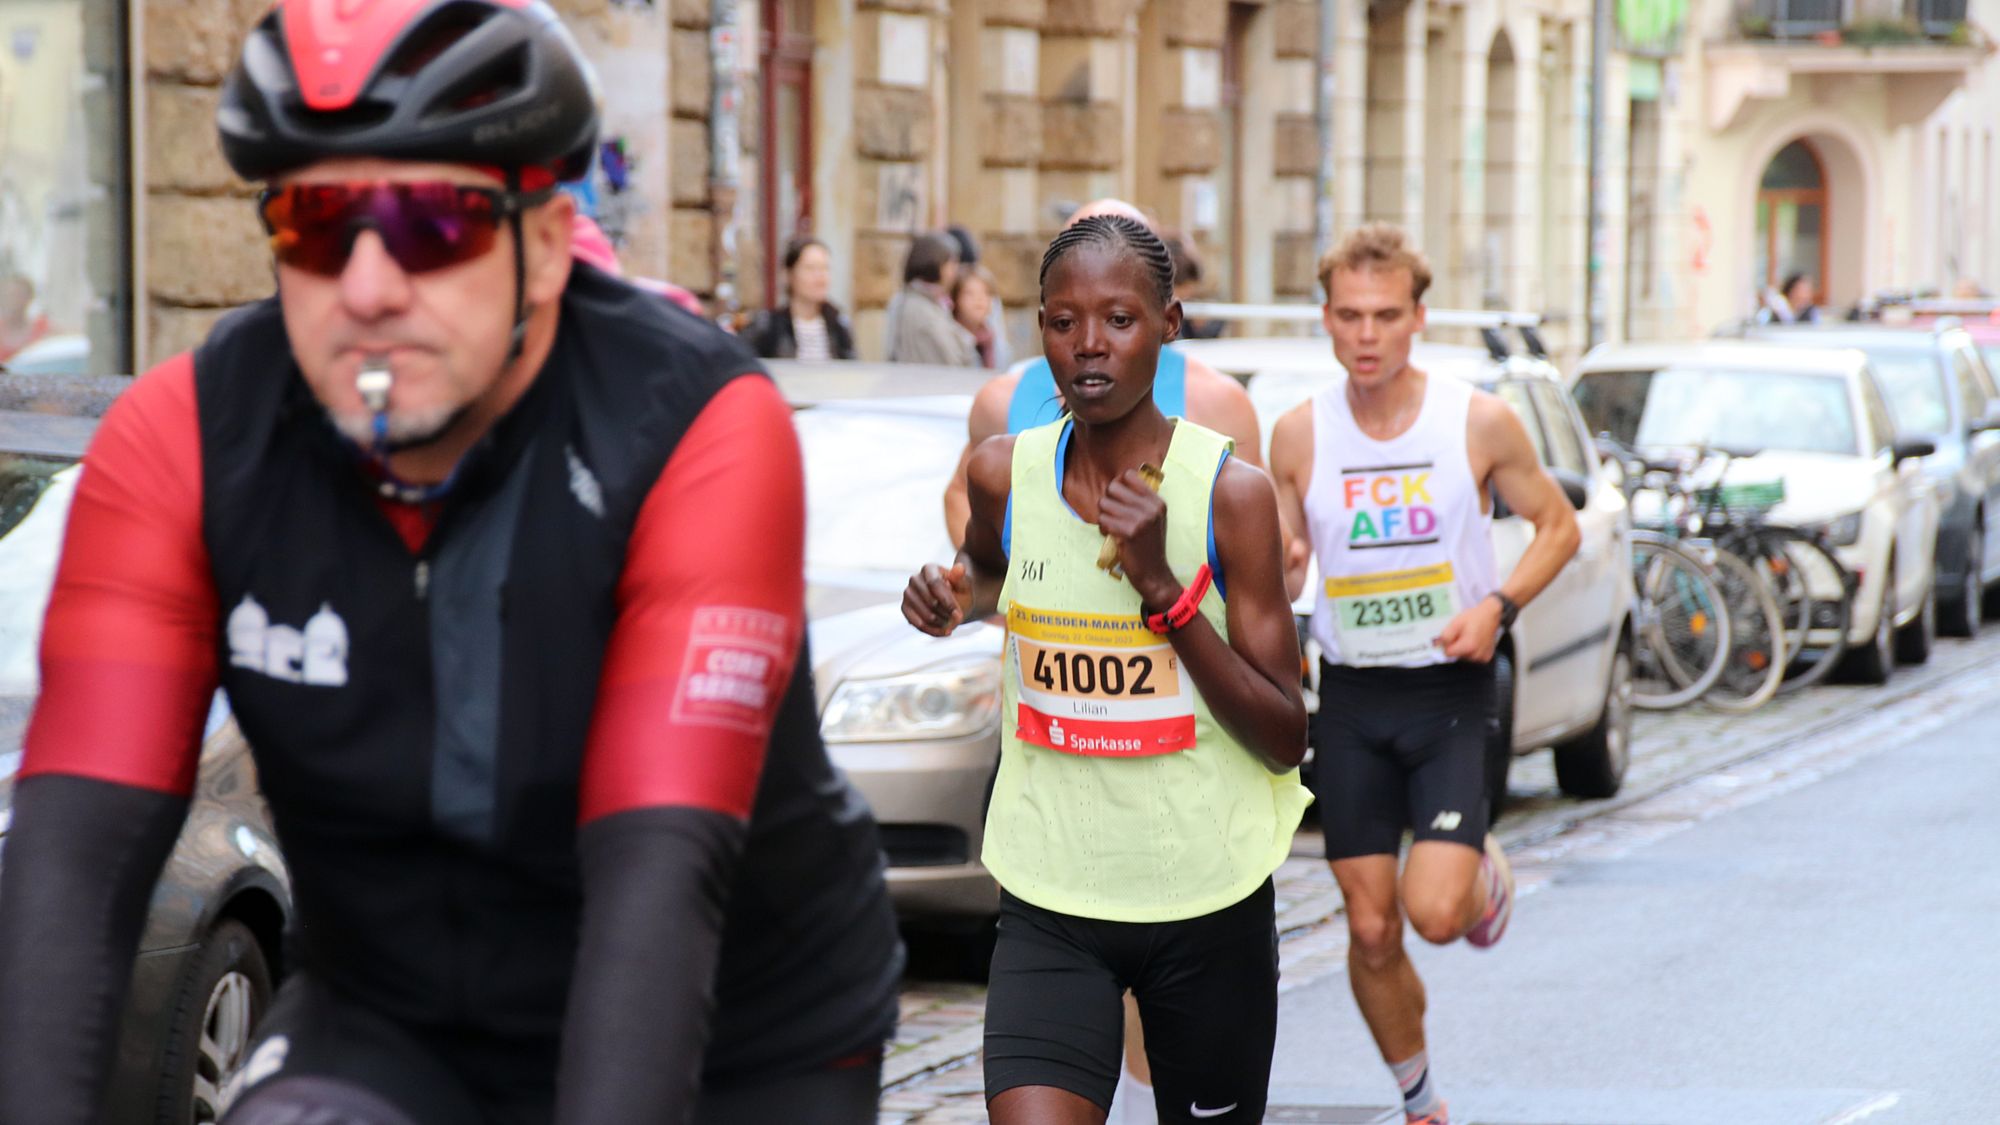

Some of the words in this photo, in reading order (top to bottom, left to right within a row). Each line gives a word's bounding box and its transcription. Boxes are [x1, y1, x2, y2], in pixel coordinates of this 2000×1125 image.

[1343, 473, 1432, 509] FCK
[1350, 506, 1437, 540] AFD
[1352, 592, 1435, 627] 23318
[1034, 649, 1155, 695] 41002
[1073, 701, 1108, 716] Lilian
[1070, 735, 1142, 751] Sparkasse
